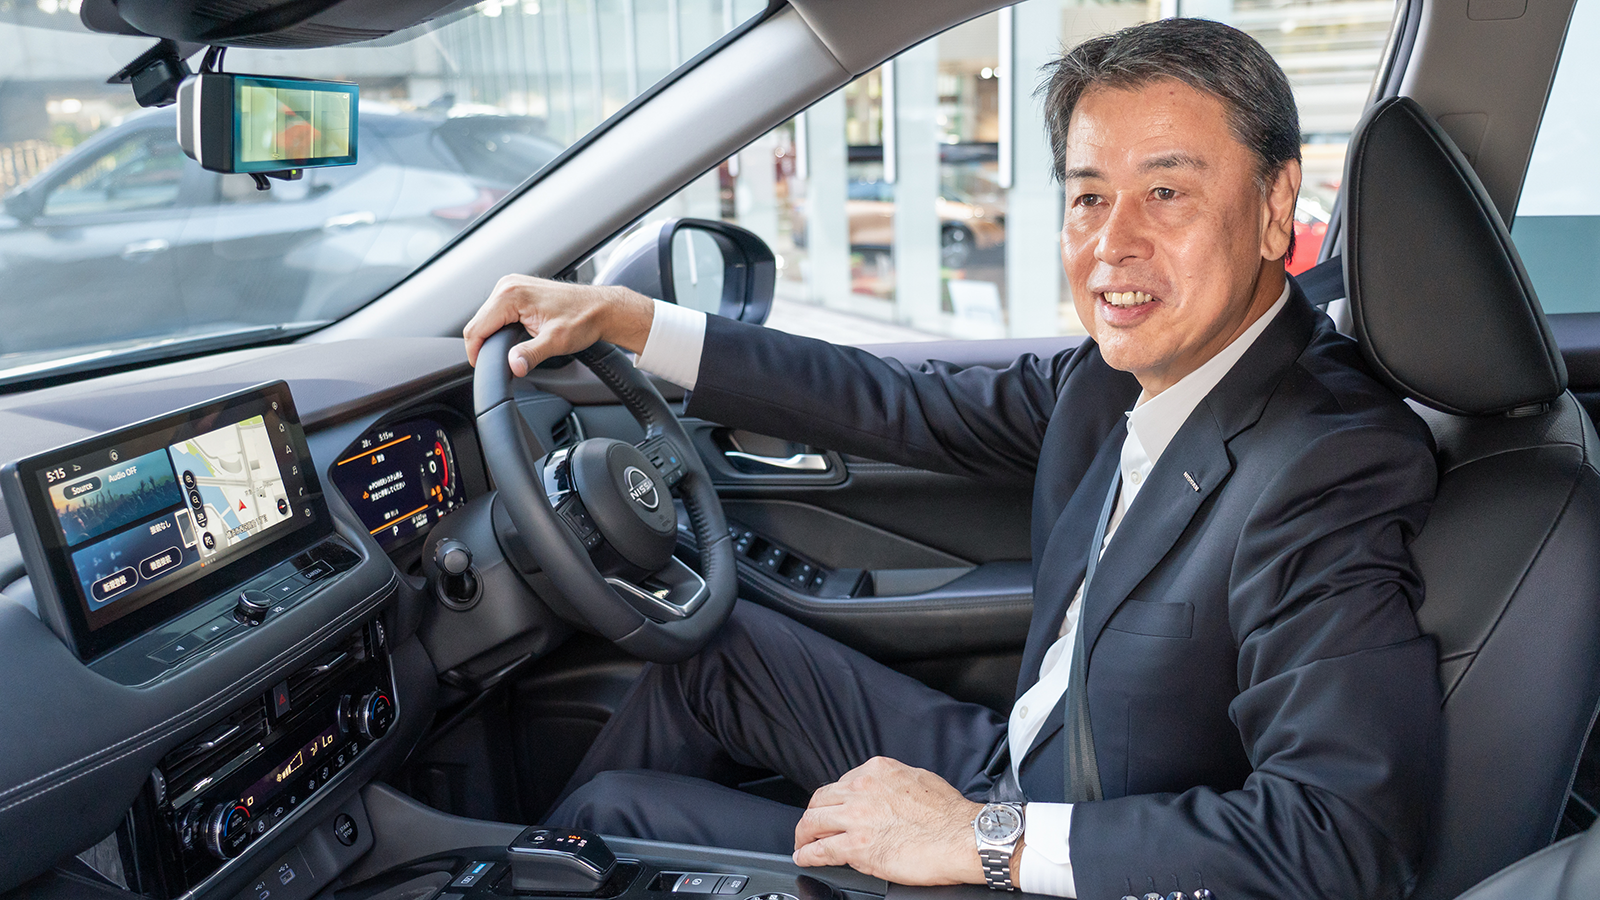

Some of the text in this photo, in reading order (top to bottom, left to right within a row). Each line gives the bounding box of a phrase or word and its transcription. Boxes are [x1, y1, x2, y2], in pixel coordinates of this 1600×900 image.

[46, 467, 66, 483] 5:15
[108, 466, 138, 483] Audio OFF
[71, 482, 94, 496] Source
[630, 480, 653, 500] NISS
[392, 525, 399, 536] P
